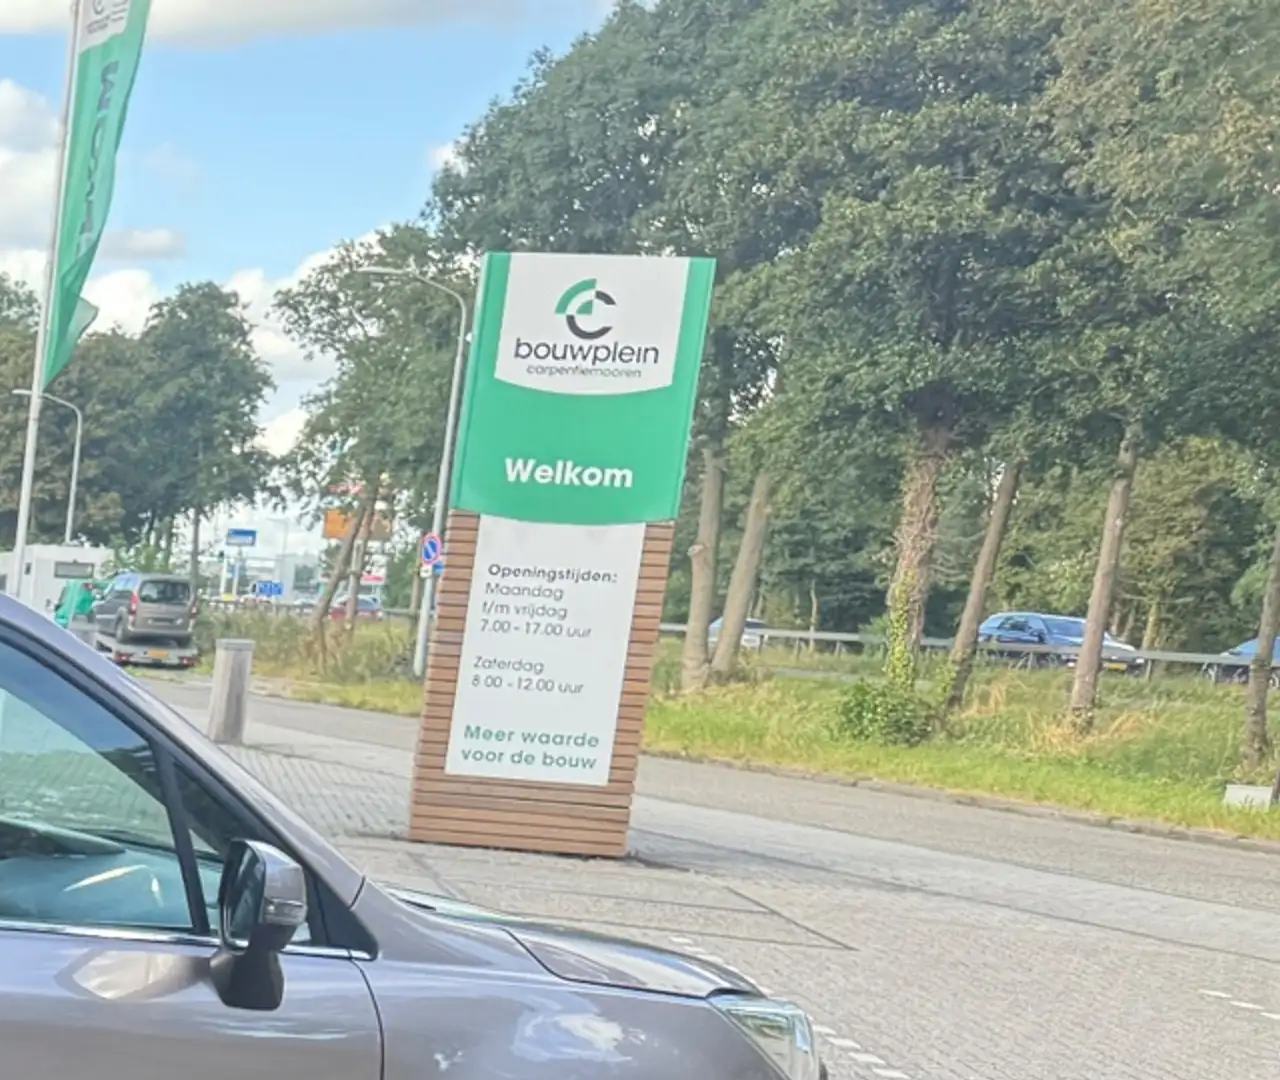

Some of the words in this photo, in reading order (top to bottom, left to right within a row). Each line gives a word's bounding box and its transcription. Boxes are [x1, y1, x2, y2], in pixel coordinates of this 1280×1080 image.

[513, 337, 659, 366] bouwplein
[504, 457, 633, 488] Welkom
[488, 563, 618, 583] Openingstijden:
[484, 582, 564, 600] Maandag
[482, 601, 510, 615] t/m
[514, 604, 568, 620] vrijdag
[480, 619, 511, 633] 7.00
[525, 621, 563, 636] 17.00
[566, 627, 592, 638] uur
[473, 655, 544, 675] Zaterdag
[517, 676, 555, 692] 12.00
[558, 681, 584, 694] uur
[464, 724, 515, 742] Meer
[521, 732, 599, 748] waarde
[461, 748, 504, 763] voor
[510, 750, 535, 765] de
[541, 751, 597, 769] bouw
